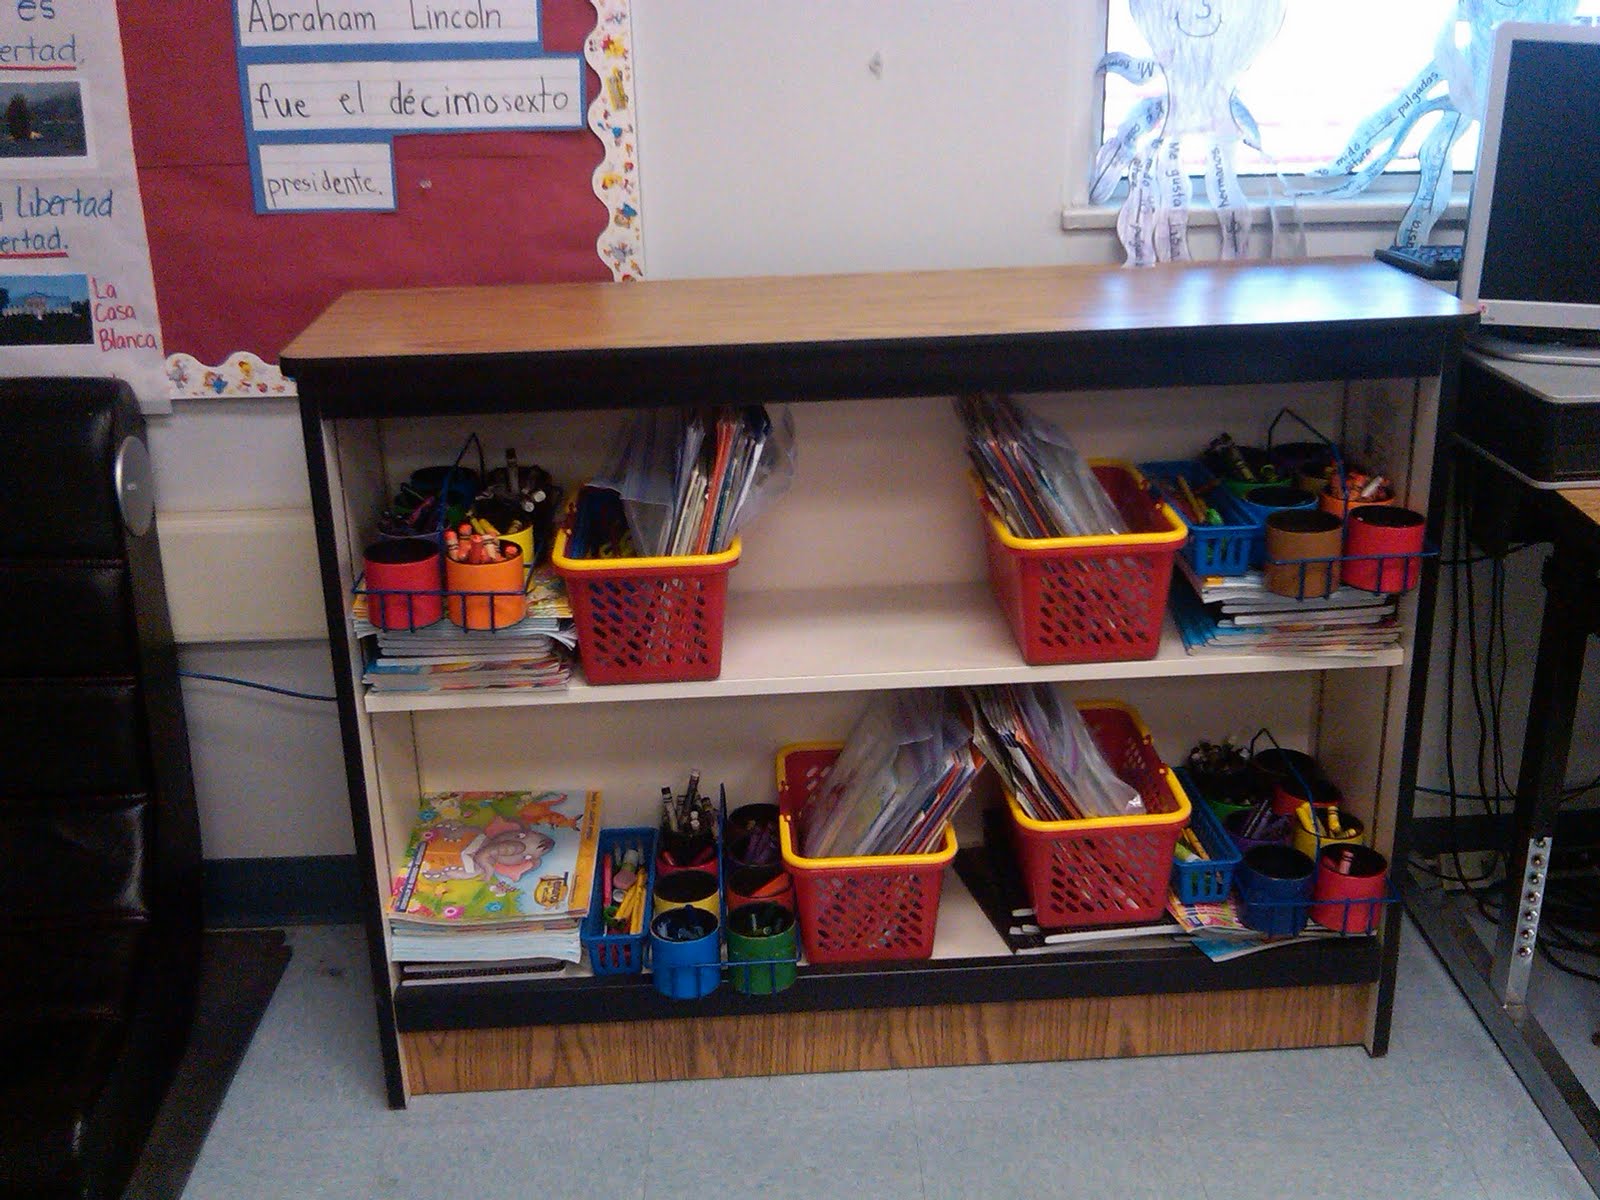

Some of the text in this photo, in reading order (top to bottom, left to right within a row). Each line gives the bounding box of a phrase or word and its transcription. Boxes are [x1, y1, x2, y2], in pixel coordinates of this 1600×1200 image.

[17, 0, 56, 21] es
[248, 0, 502, 32] Abraham Lincoln
[255, 76, 569, 119] fue el décimosexto
[1335, 142, 1361, 167] mido
[1397, 71, 1439, 118] pulgadas
[1168, 142, 1180, 160] Me
[1165, 169, 1185, 208] gusta
[1212, 146, 1230, 209] hermanos
[91, 277, 118, 299] La
[94, 302, 137, 322] Casa
[97, 328, 158, 352] Blanca
